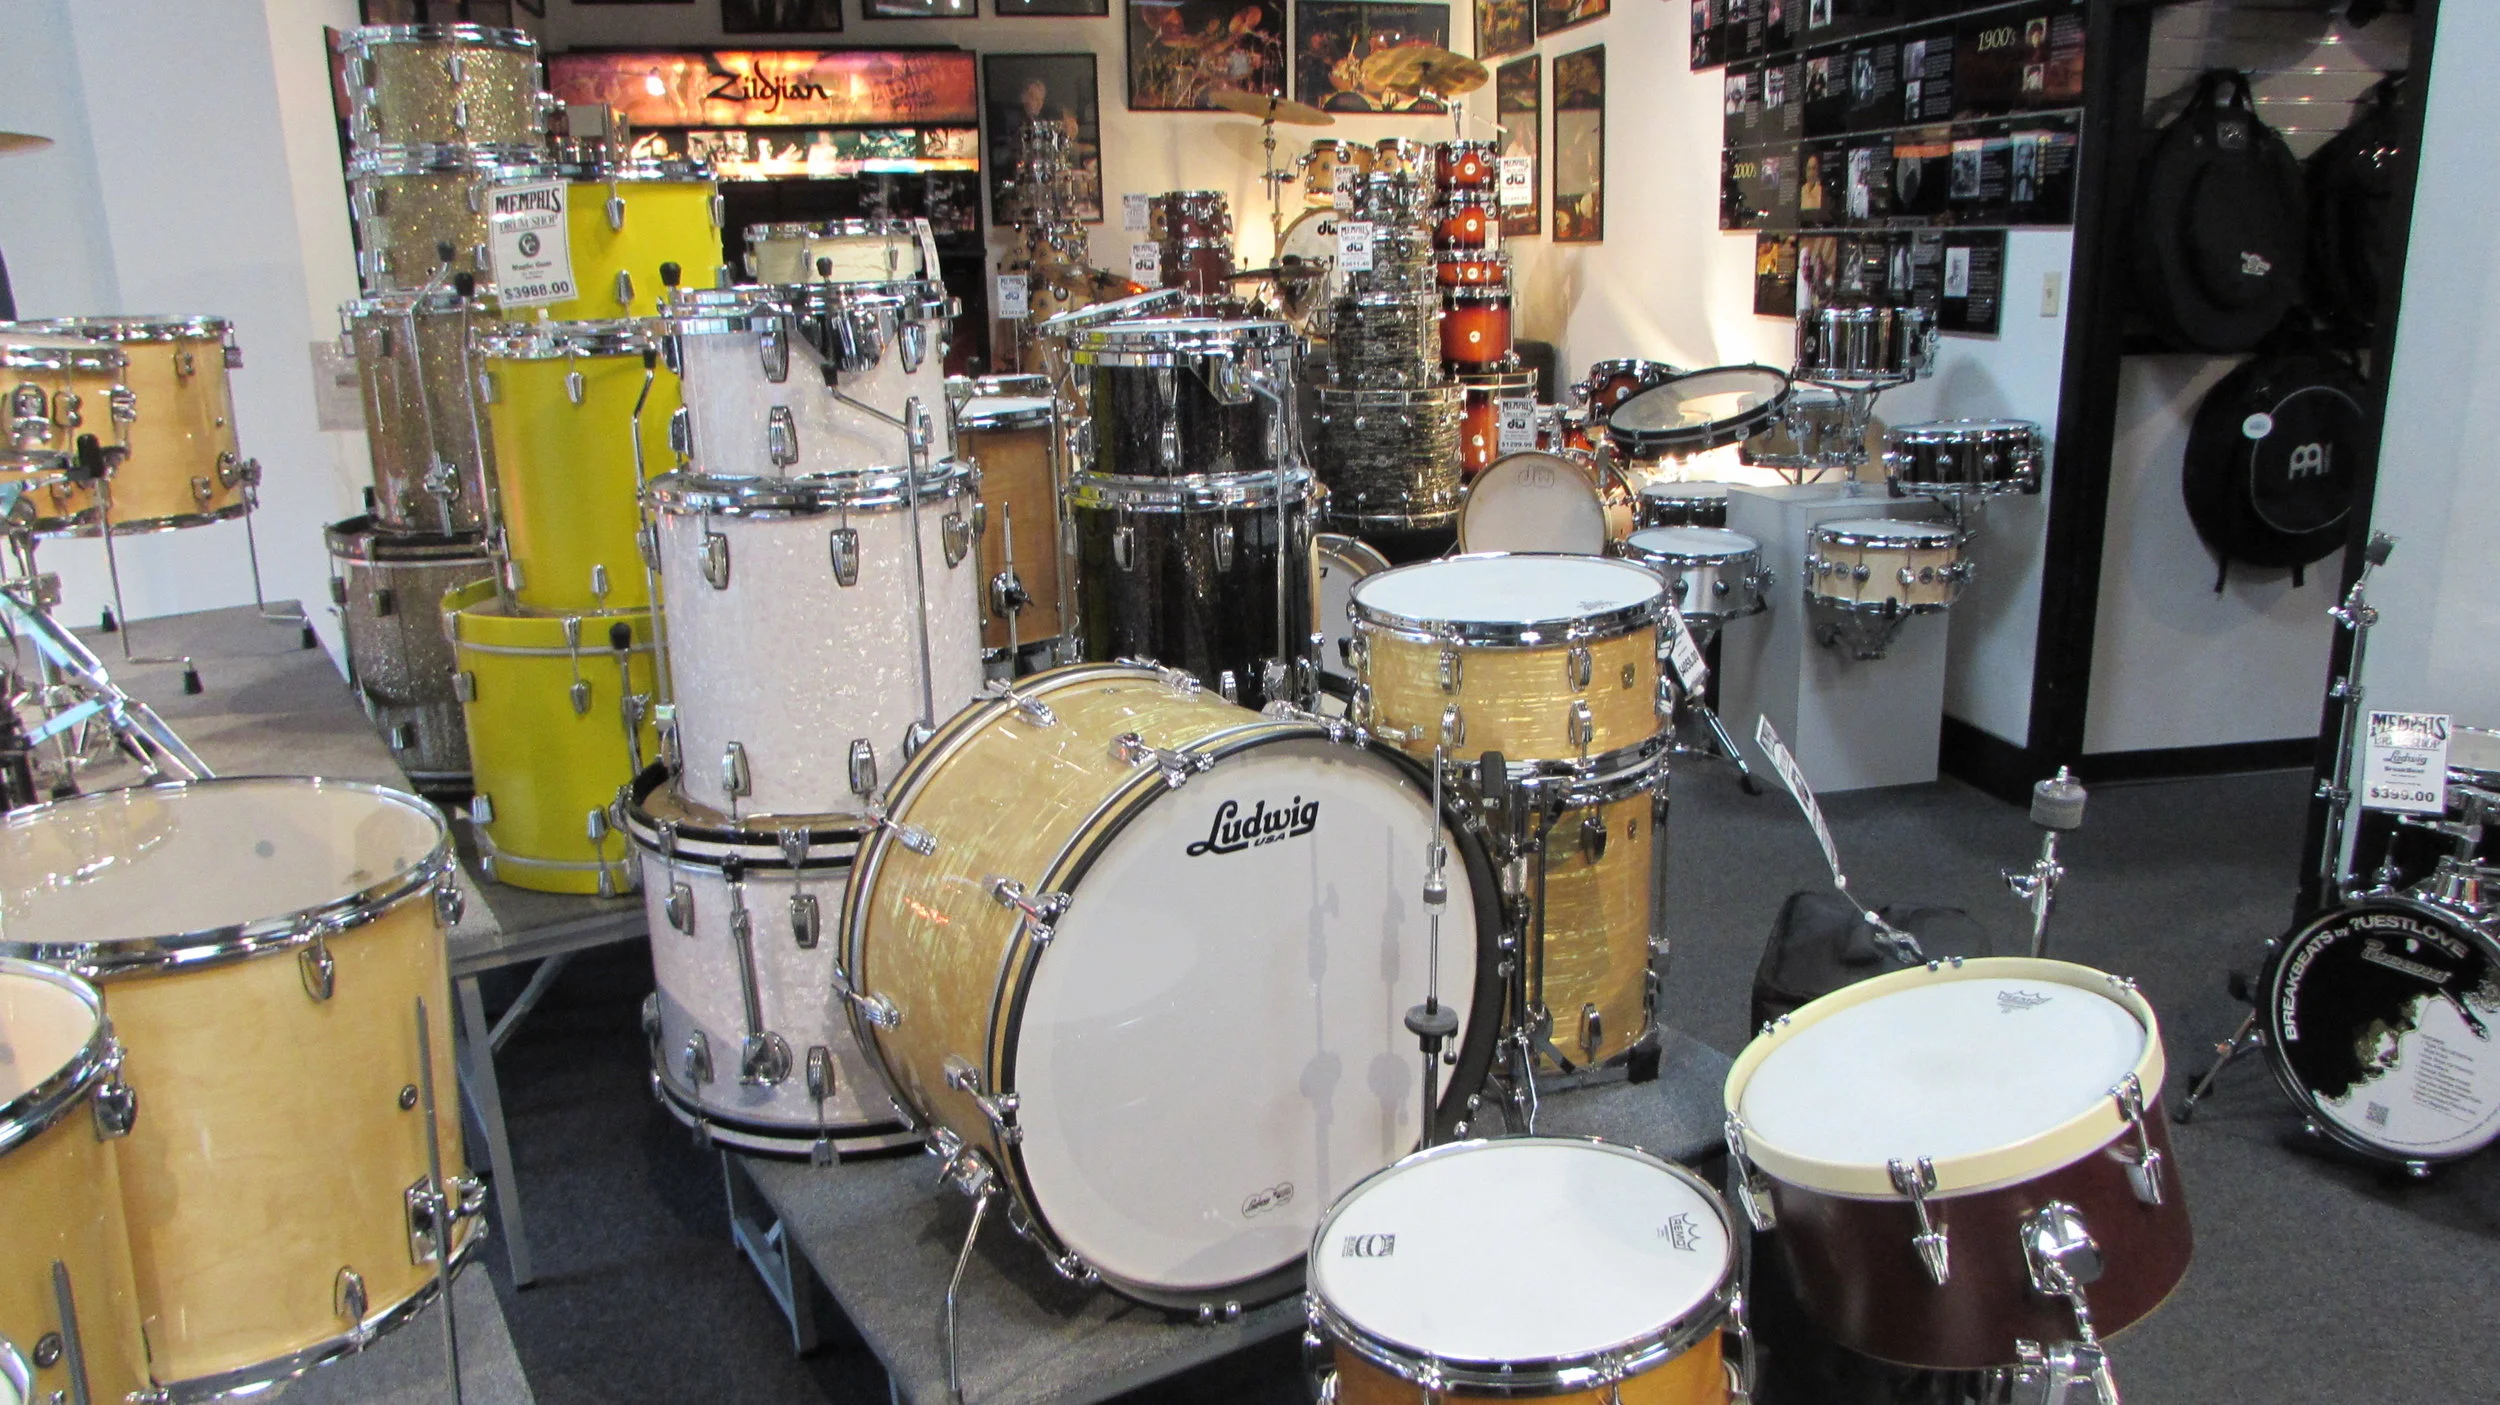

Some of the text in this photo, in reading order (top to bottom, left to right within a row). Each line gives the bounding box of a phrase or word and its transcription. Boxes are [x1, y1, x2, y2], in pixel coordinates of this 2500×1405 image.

[1977, 25, 2016, 52] 1900's
[706, 60, 830, 114] Zildjian
[1506, 174, 1526, 185] dw
[495, 188, 562, 213] MEMPHIS
[1346, 242, 1363, 252] dw
[1502, 401, 1533, 413] MEMPHIS
[1507, 419, 1526, 429] dw
[2370, 713, 2446, 740] MEMPHIS
[2383, 750, 2428, 766] Ludwig
[2370, 788, 2435, 802] $399.00
[1186, 795, 1319, 857] Ludwig
[1254, 832, 1285, 847] USA
[2282, 930, 2335, 1041] BREAKBEATS
[2335, 926, 2350, 938] by
[1673, 1218, 1687, 1248] REMO
